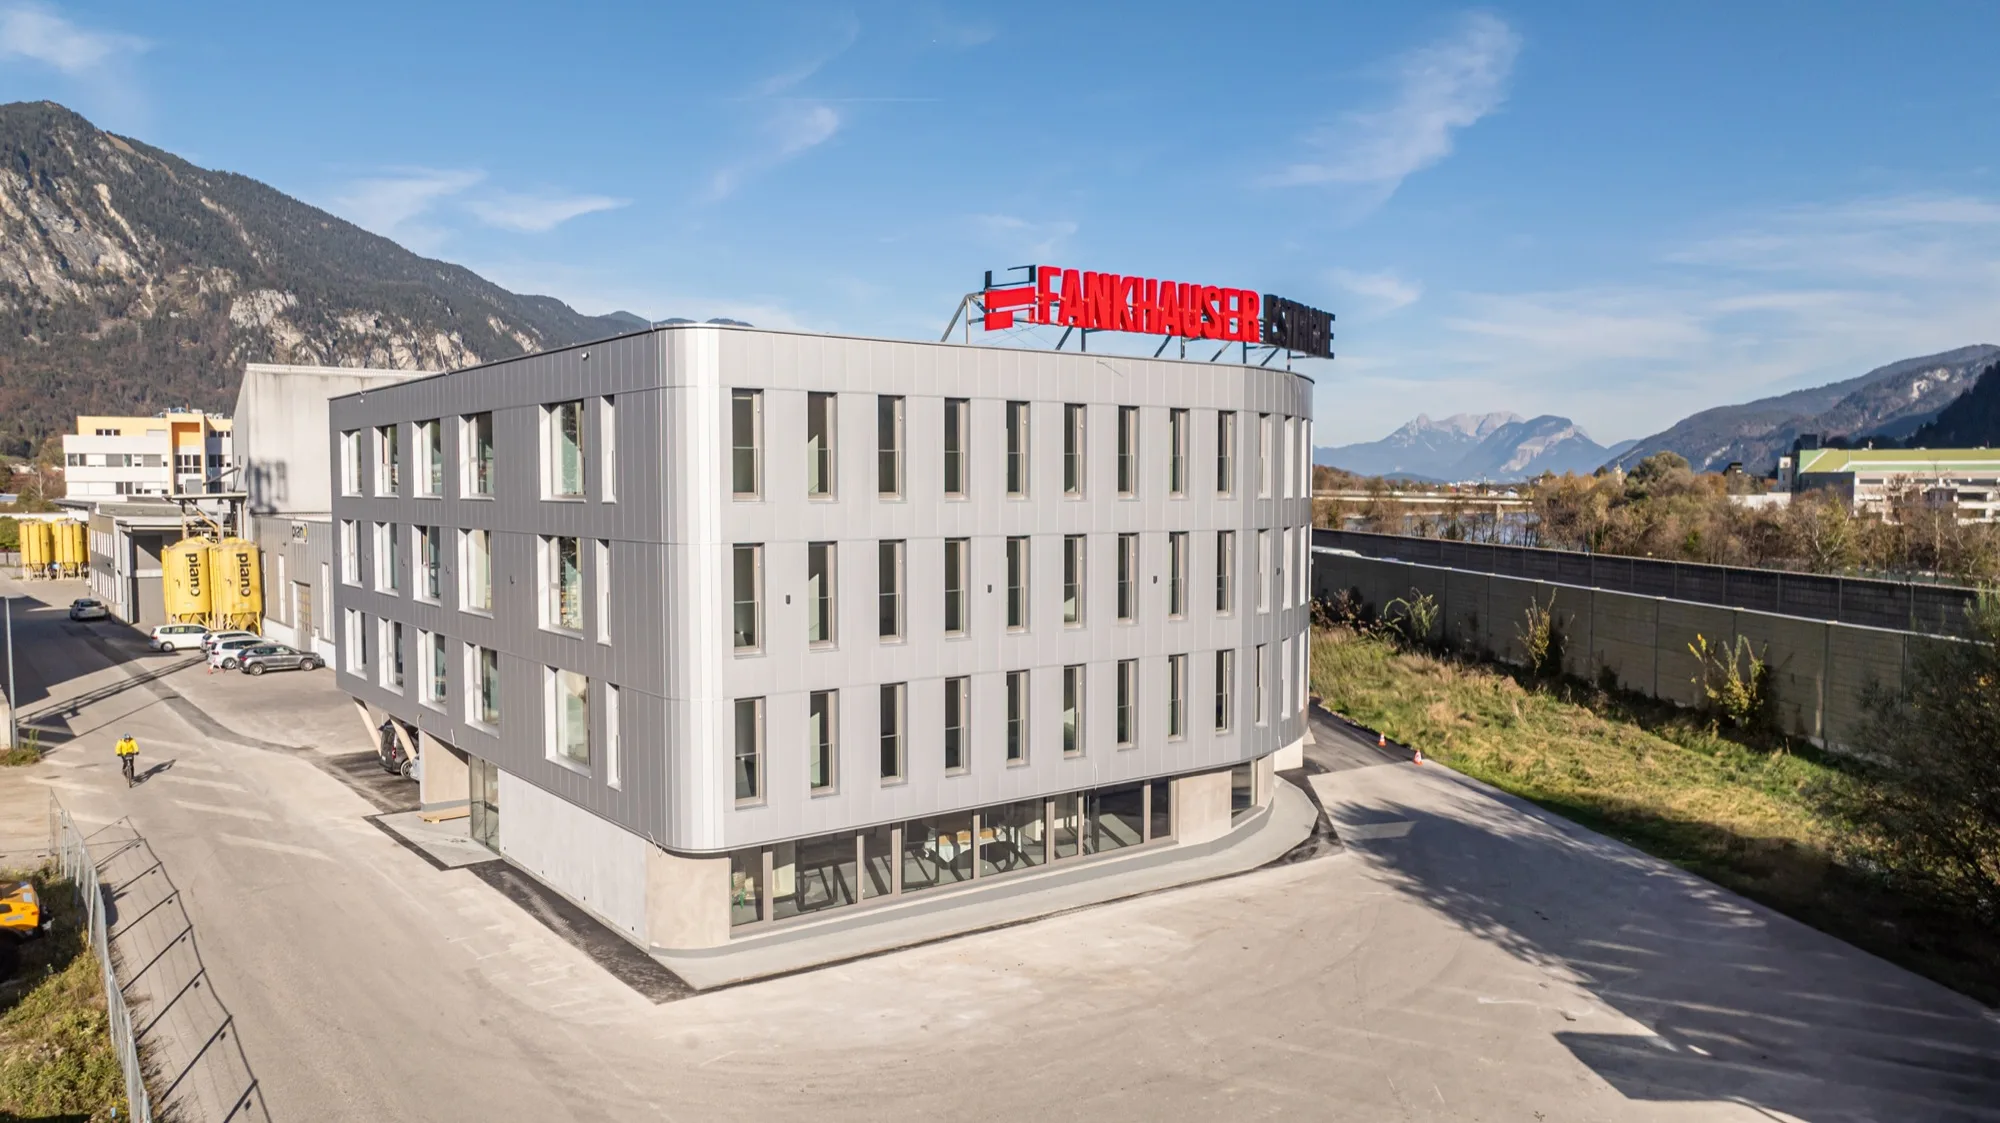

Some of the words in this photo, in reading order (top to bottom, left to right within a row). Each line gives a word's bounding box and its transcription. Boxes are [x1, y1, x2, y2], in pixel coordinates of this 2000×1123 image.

[1038, 266, 1260, 343] FANKHAUSER
[185, 553, 201, 597] piano
[236, 553, 251, 597] piano
